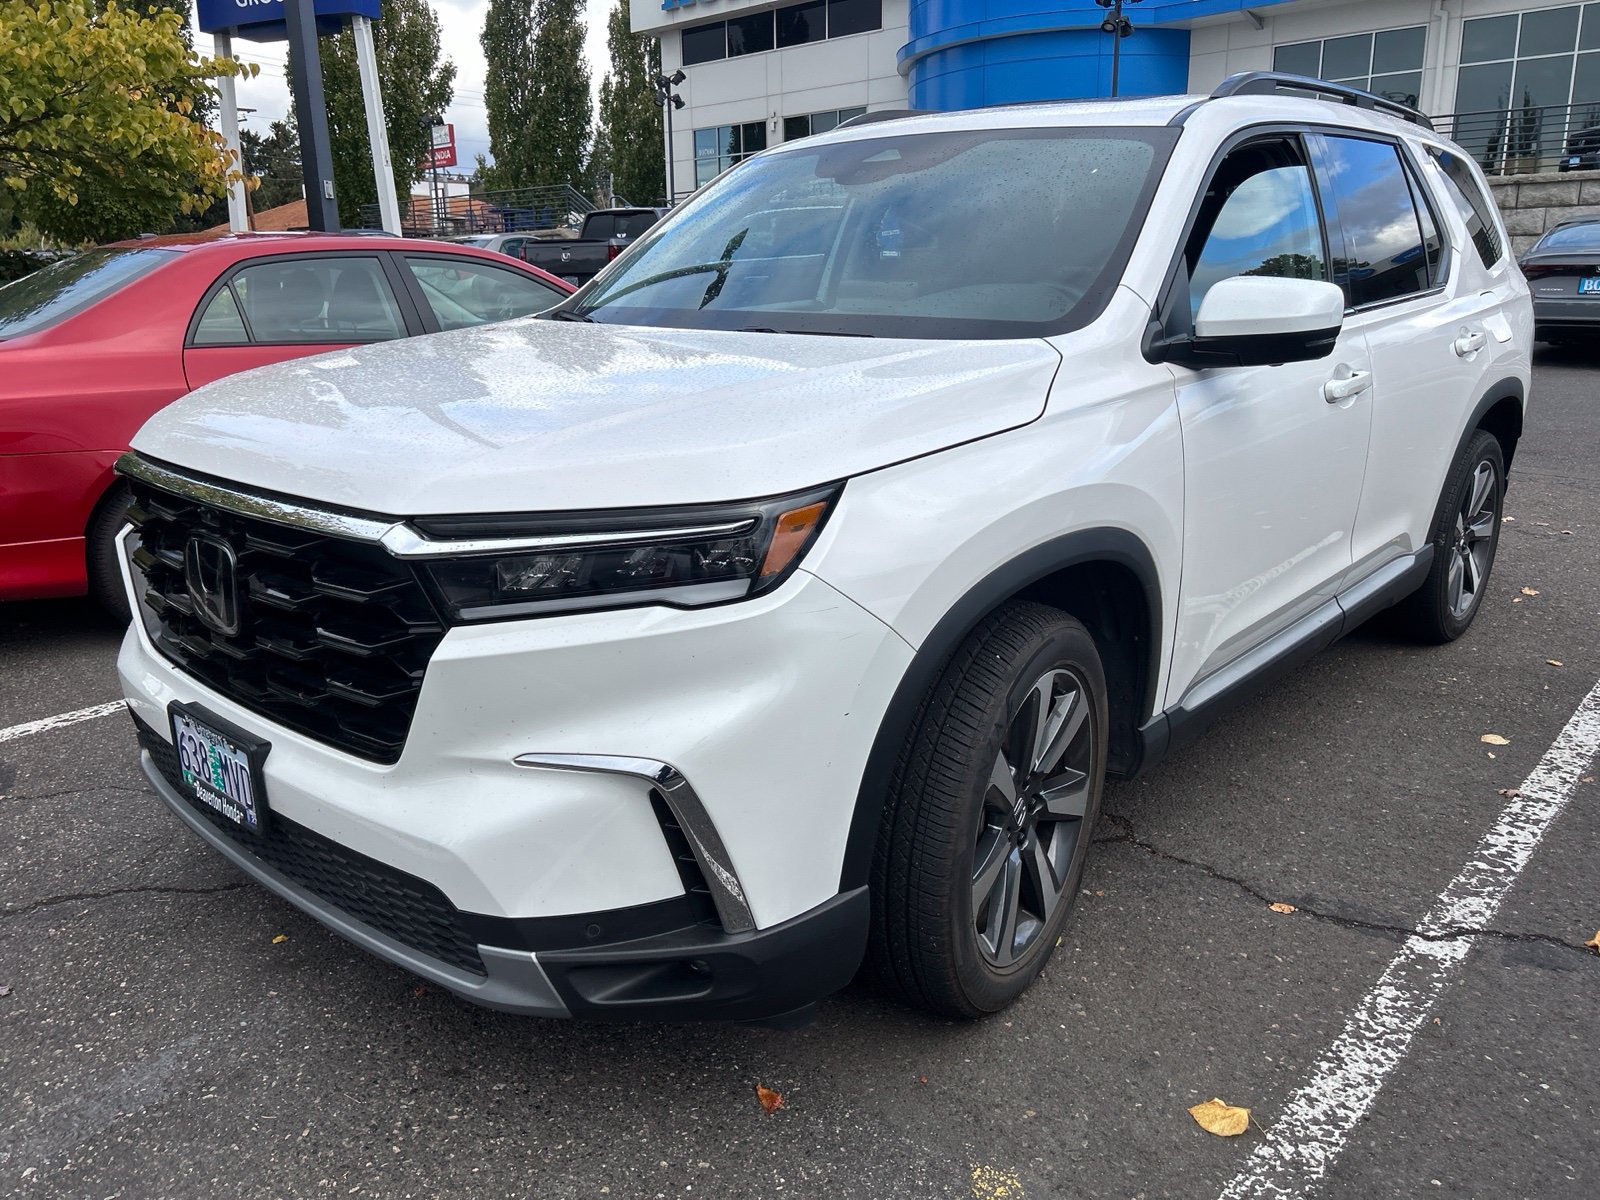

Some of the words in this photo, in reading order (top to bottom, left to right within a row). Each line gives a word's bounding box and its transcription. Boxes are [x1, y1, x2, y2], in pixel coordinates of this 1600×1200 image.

[179, 730, 212, 783] 638
[196, 780, 222, 812] Beaverton
[221, 797, 241, 824] Honda
